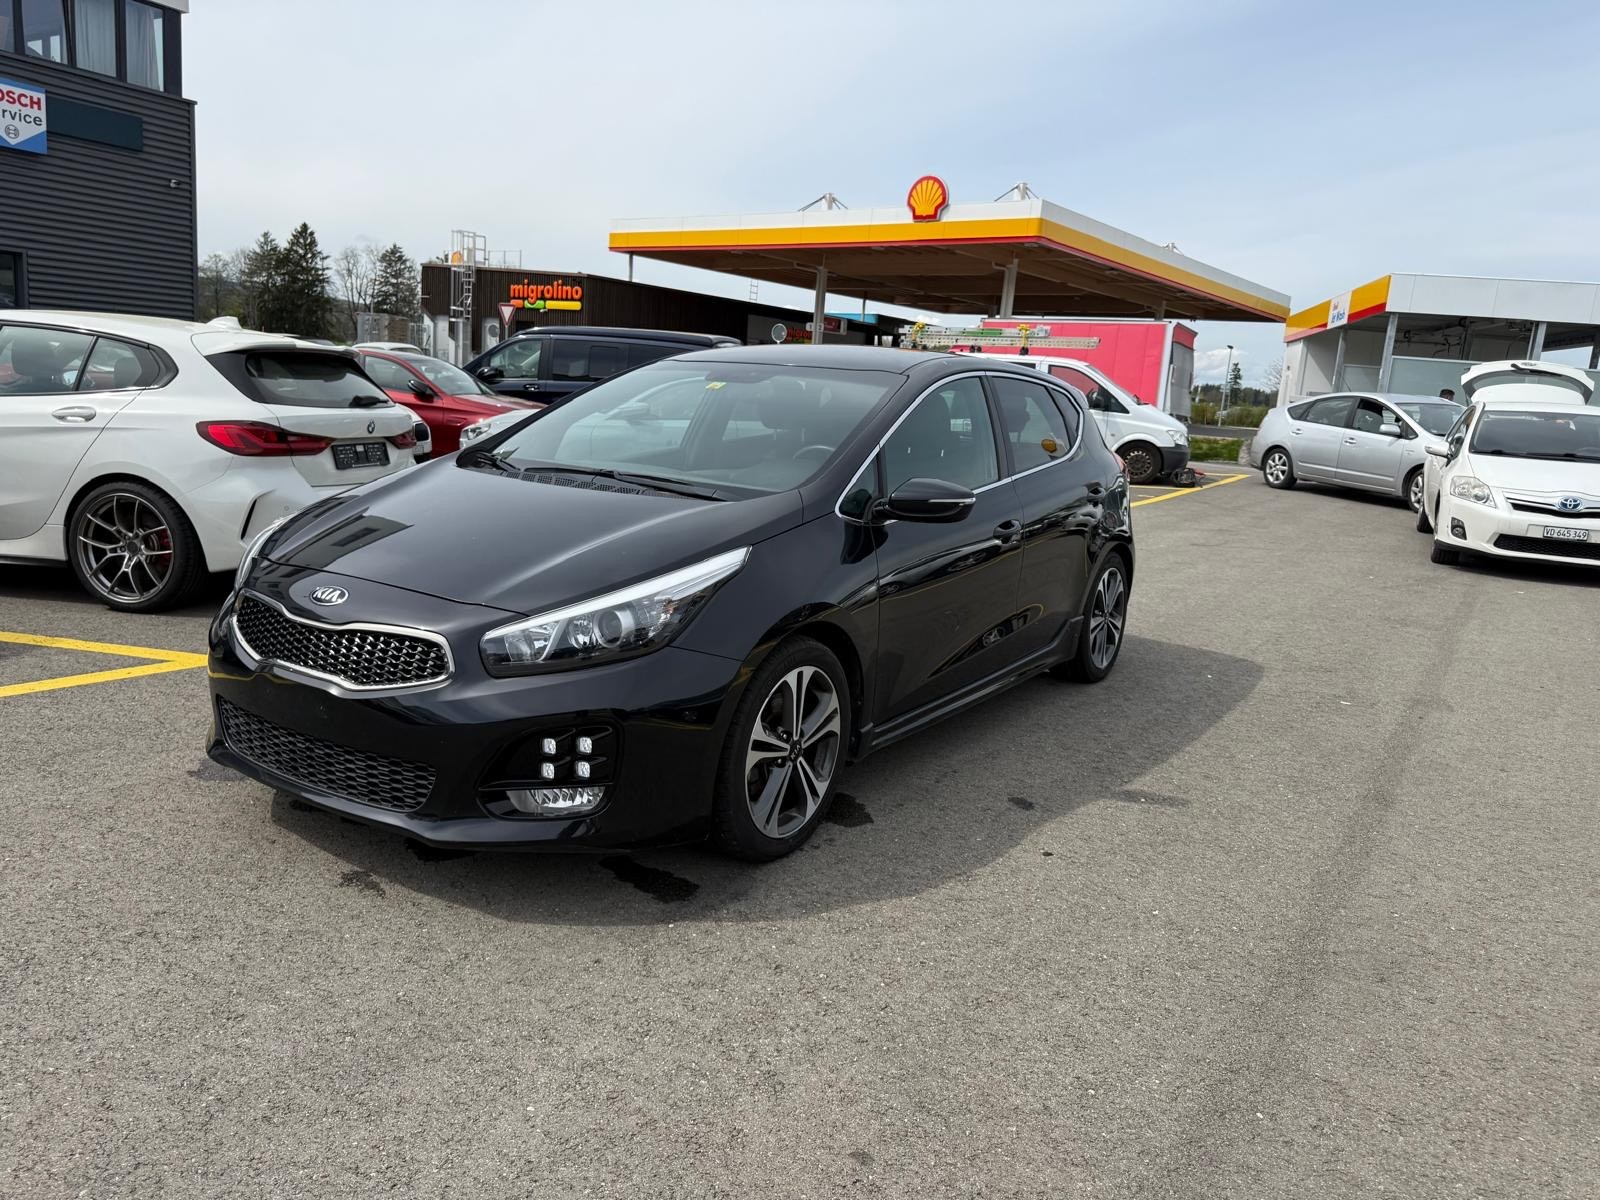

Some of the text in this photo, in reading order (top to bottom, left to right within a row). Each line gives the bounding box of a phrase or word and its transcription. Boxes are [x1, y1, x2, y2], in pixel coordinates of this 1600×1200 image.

[510, 278, 582, 304] migrolino
[1545, 528, 1587, 539] VD 645 349
[313, 586, 342, 602] KIA
